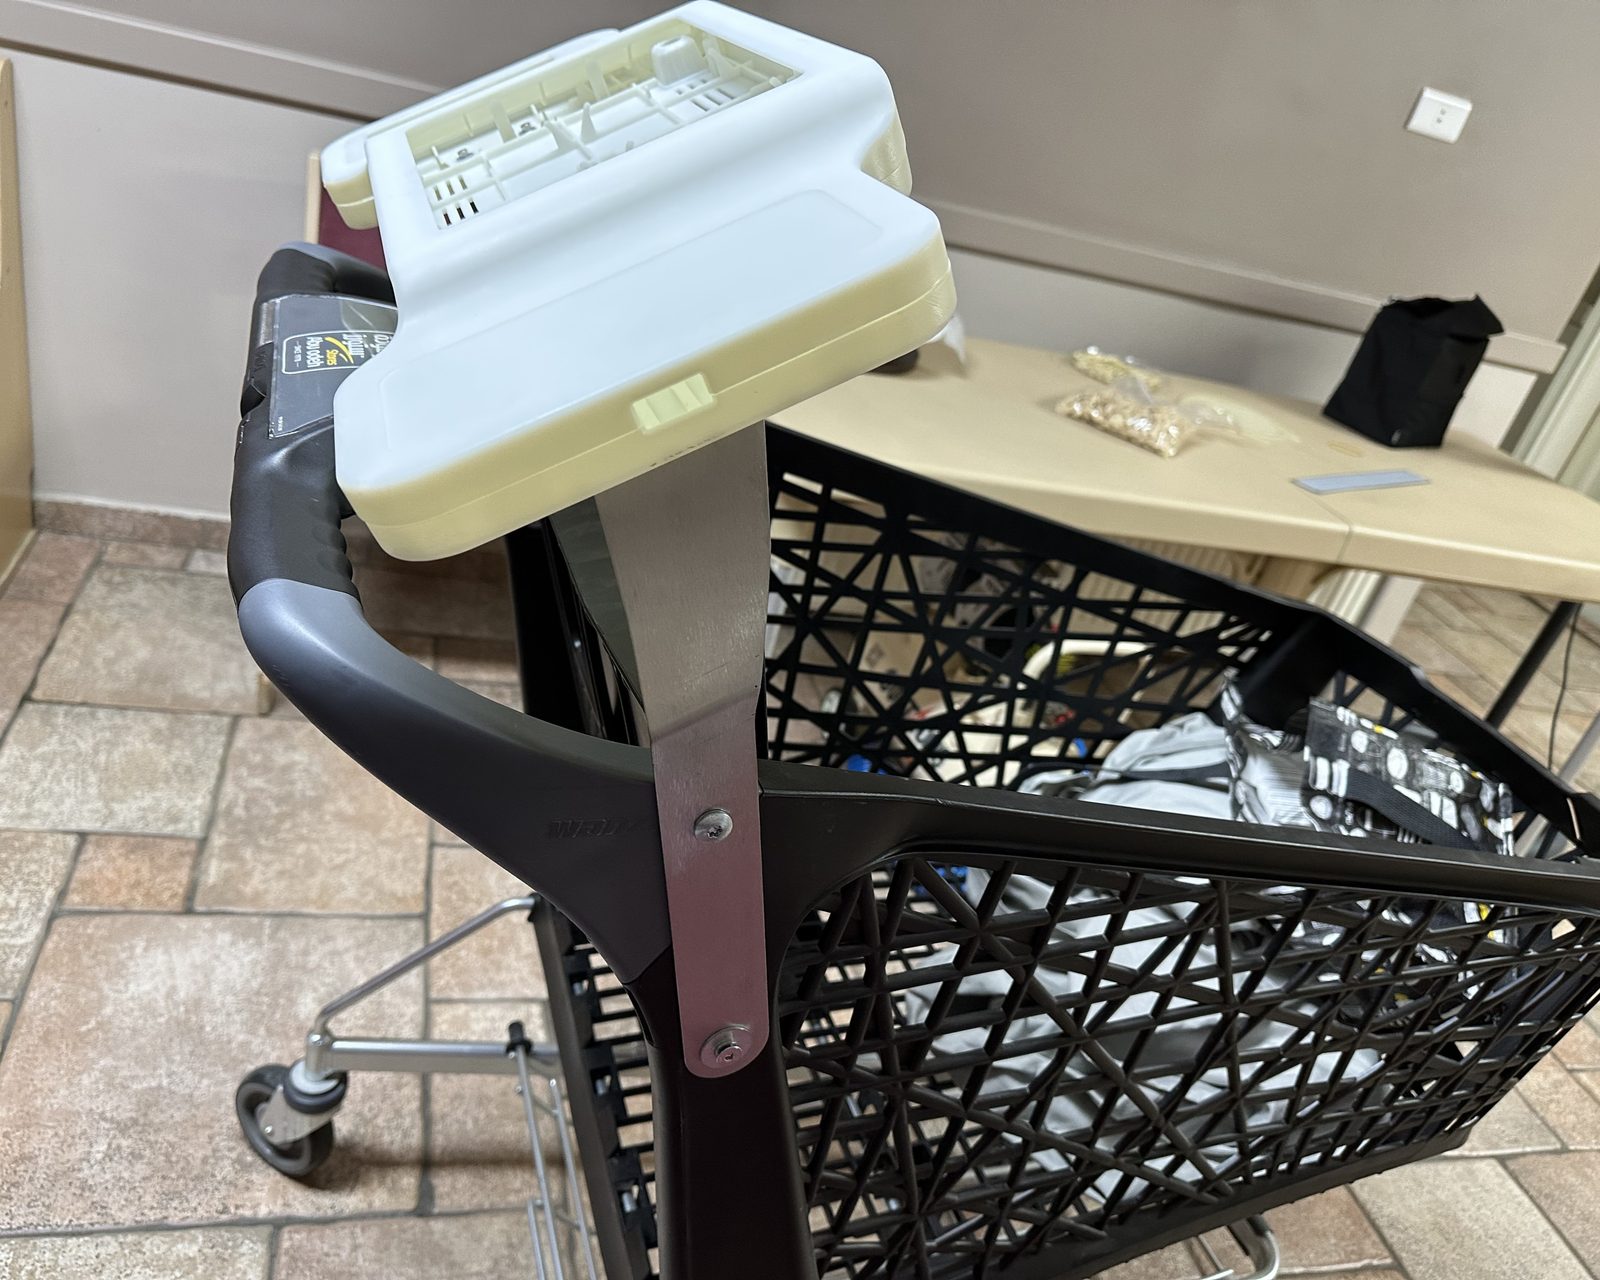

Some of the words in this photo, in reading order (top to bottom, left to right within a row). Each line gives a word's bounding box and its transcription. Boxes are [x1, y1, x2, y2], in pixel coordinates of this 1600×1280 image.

[307, 336, 323, 349] Abu
[307, 350, 325, 367] odeh
[326, 349, 339, 365] Stores
